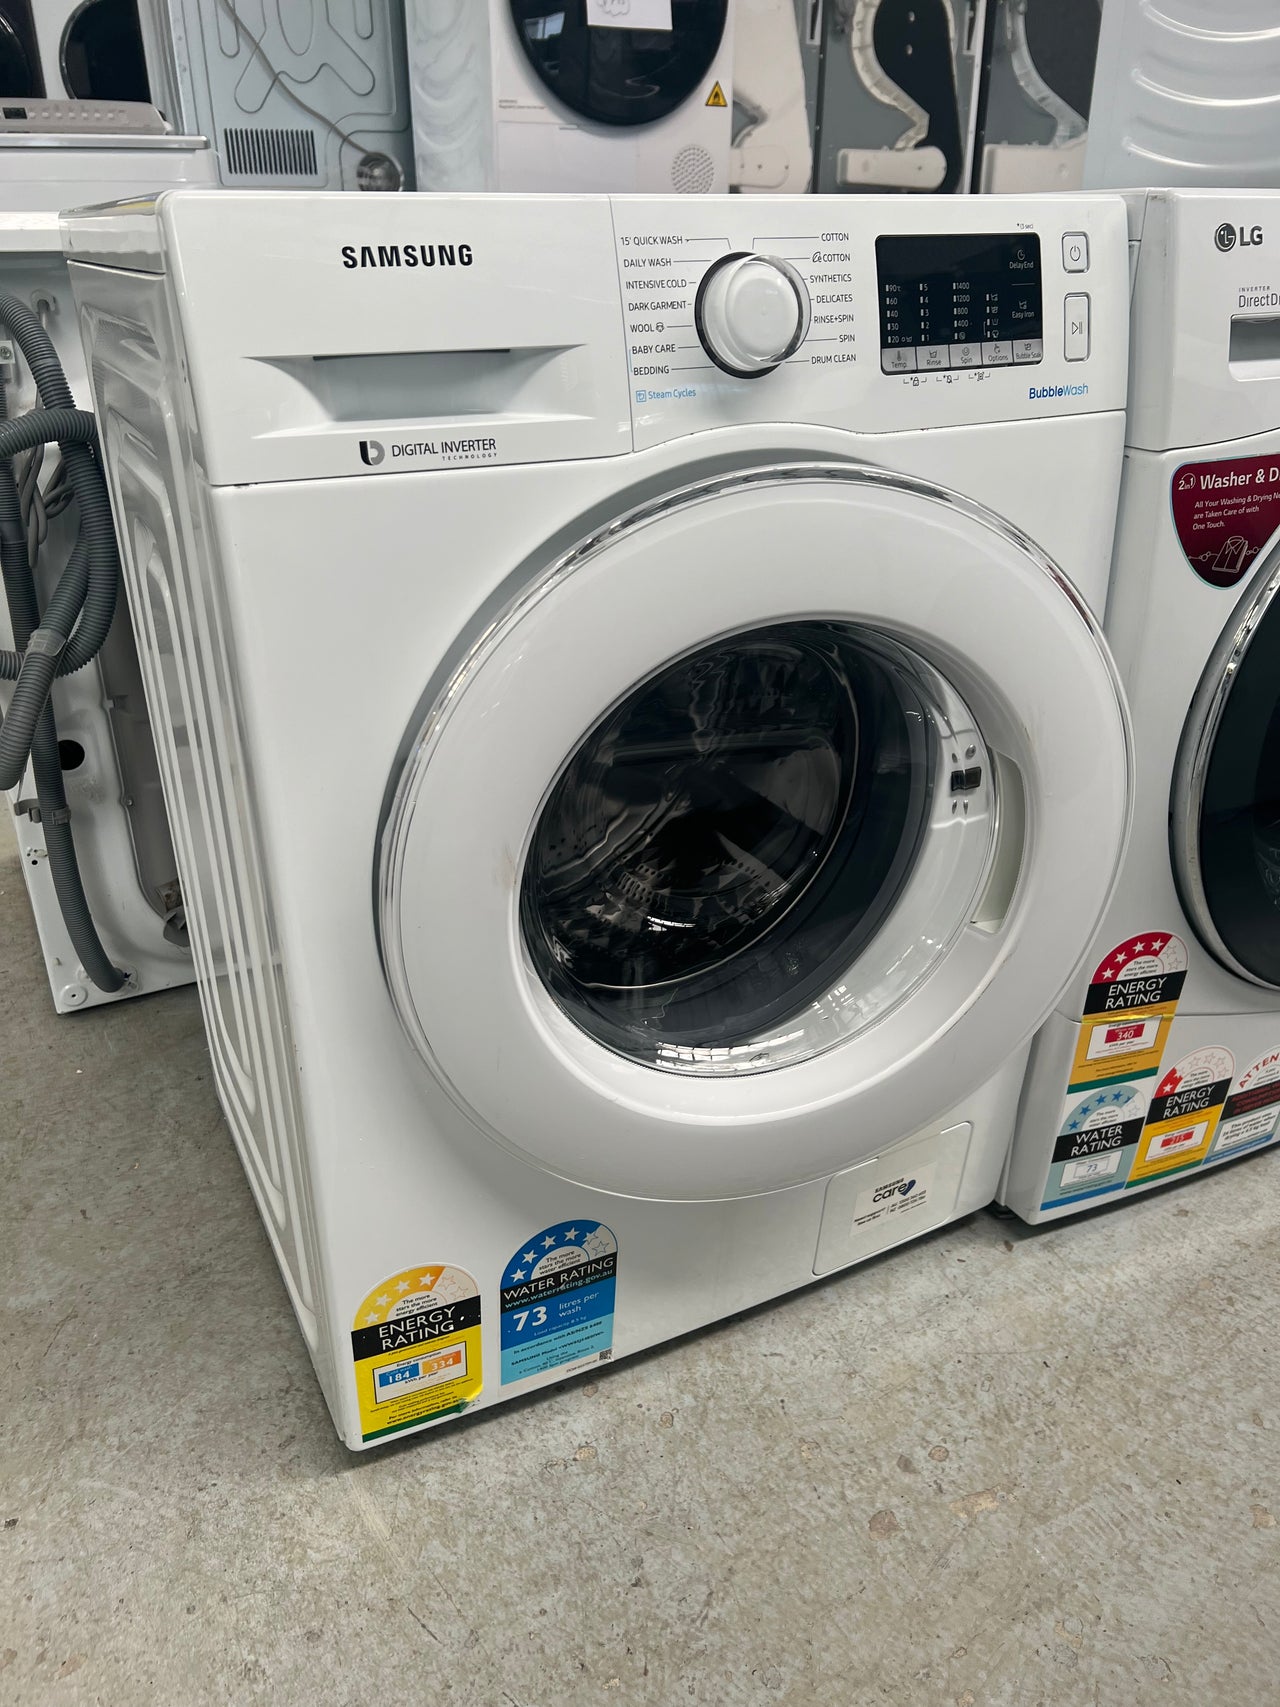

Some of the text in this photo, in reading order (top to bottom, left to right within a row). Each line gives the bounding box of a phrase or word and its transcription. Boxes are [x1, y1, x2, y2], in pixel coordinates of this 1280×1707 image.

[633, 236, 659, 246] QUICK
[659, 235, 683, 245] WASH
[821, 232, 849, 242] COTTON
[1239, 225, 1264, 247] LG
[341, 244, 474, 269] SAMSUNG
[822, 253, 851, 263] COTTON
[623, 258, 672, 268] DAILY WASH
[625, 279, 687, 289] INTENSIVE COLD
[809, 273, 852, 284] SYNTHETICS
[924, 283, 928, 291] 5
[956, 282, 970, 290] 1400
[1238, 285, 1271, 293] INVERTER
[816, 293, 853, 304] DELICATES
[890, 297, 898, 305] 60
[924, 296, 929, 304] 4
[956, 294, 970, 302] 1200
[1238, 293, 1280, 308] DirectD
[628, 300, 687, 312] DARK GARMENT
[890, 310, 899, 318] 40
[925, 309, 929, 317] 3
[1011, 311, 1024, 320] Easy
[813, 314, 854, 324] RINSE+SPIN
[958, 319, 969, 327] 400
[629, 323, 655, 333] WOOL
[891, 323, 899, 331] 30
[925, 321, 930, 329] 2
[838, 334, 856, 343] SPIN
[891, 336, 900, 344] 20
[631, 344, 676, 355] BABY CARE
[811, 354, 857, 365] DRUM CLEAN
[960, 356, 973, 364] Spin
[988, 354, 1009, 362] Options
[1015, 352, 1031, 360] Bubble
[633, 365, 670, 376] BEDDING
[648, 388, 697, 400] Steam Cycles
[1029, 384, 1089, 400] BubbleWash
[391, 438, 497, 458] DIGITAL INVERTER
[442, 453, 498, 462] TECHNOLOGY
[1200, 471, 1252, 490] Washer
[1255, 468, 1265, 483] &
[1269, 467, 1280, 482] D
[1195, 501, 1204, 509] All
[1204, 500, 1219, 508] Your
[1220, 496, 1246, 506] Washing
[1246, 495, 1252, 503] &
[1252, 493, 1273, 503] Drying
[1193, 512, 1204, 520] are
[1223, 508, 1237, 517] Care
[1246, 505, 1260, 513] with
[1192, 521, 1226, 531] One Touch.
[1108, 977, 1167, 997] ENERGY
[1105, 990, 1162, 1010] RATING
[1117, 1029, 1134, 1041] 340
[1165, 1085, 1216, 1108] ENERGY
[1162, 1097, 1210, 1120] RATING
[1076, 1124, 1122, 1144] WATER
[1070, 1136, 1122, 1157] RATING
[1086, 1163, 1098, 1173] 73
[872, 1183, 908, 1203] care
[558, 1250, 575, 1258] more
[538, 1262, 553, 1270] stars
[565, 1253, 581, 1262] more
[539, 1259, 581, 1275] water efficient
[503, 1257, 614, 1301] WATER RATING
[414, 1294, 431, 1302] more
[421, 1297, 437, 1305] more
[559, 1292, 600, 1311] litres per
[395, 1301, 438, 1318] energy efficient
[558, 1306, 582, 1318] wash
[379, 1306, 456, 1338] ENERGY
[512, 1305, 548, 1332] 73
[382, 1320, 455, 1351] RATING
[396, 1360, 413, 1368] Energy
[389, 1370, 410, 1384] 184
[431, 1357, 454, 1372] 334
